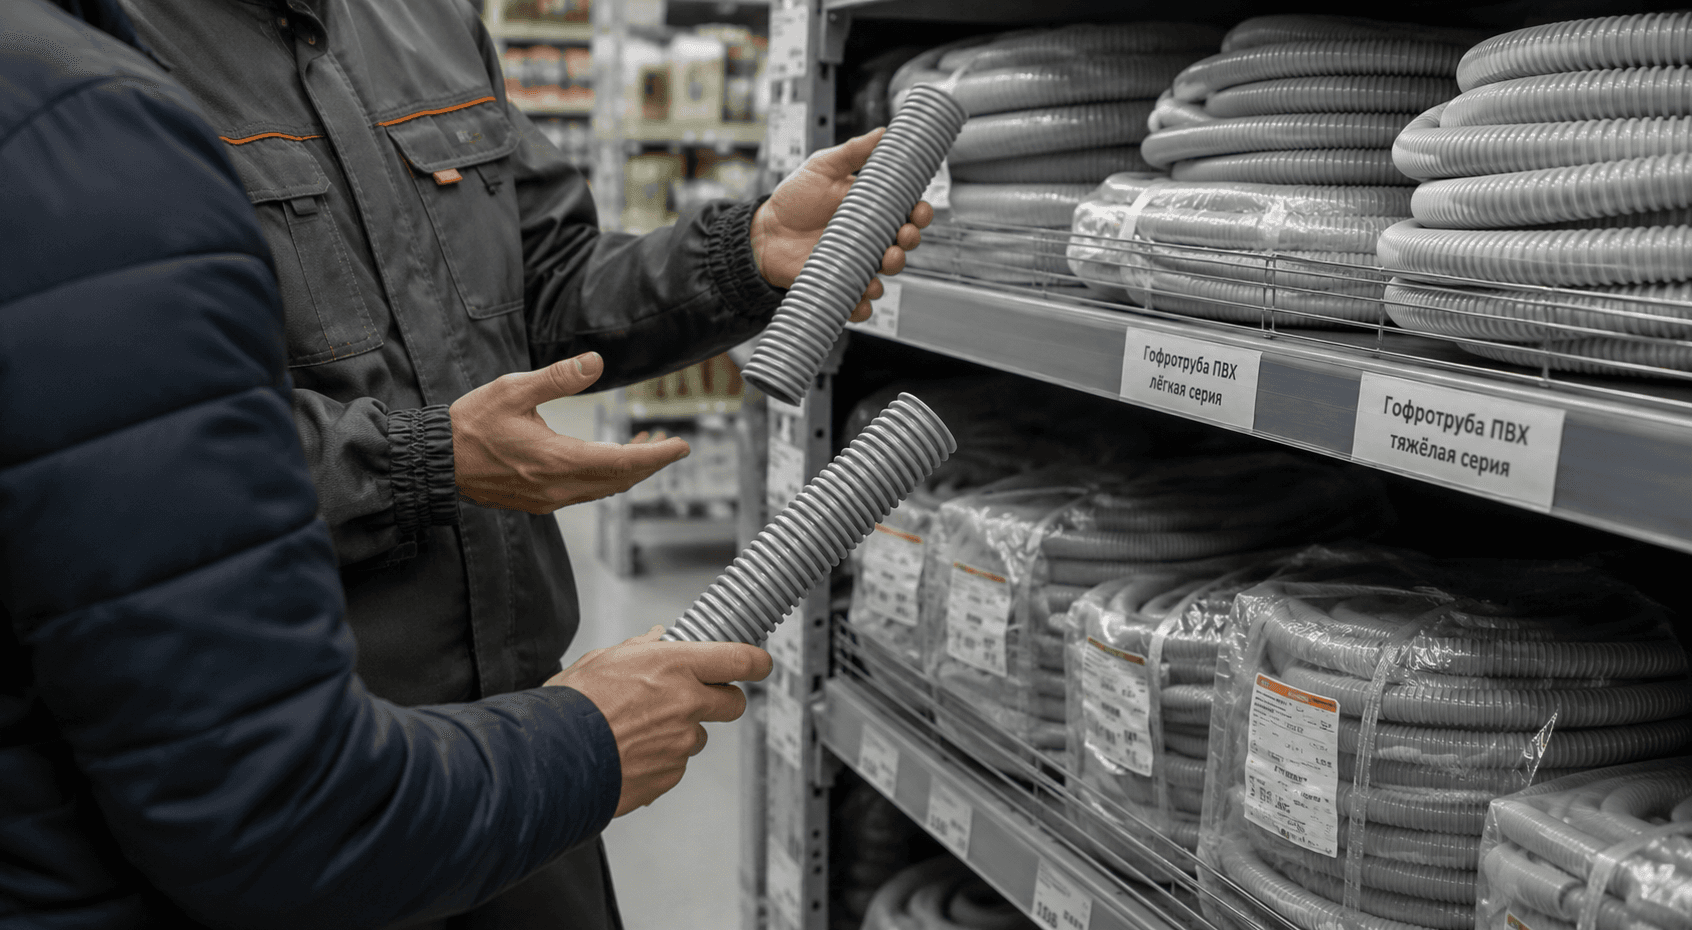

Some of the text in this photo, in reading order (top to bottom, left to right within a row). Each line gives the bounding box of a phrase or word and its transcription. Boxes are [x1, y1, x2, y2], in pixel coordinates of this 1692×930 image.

[1143, 345, 1238, 381] Гофротруба ПВХ
[1149, 375, 1223, 406] лёгкая серия
[1383, 395, 1531, 446] Гофротруба ПВХ
[1390, 433, 1511, 478] тяжёлая серия
